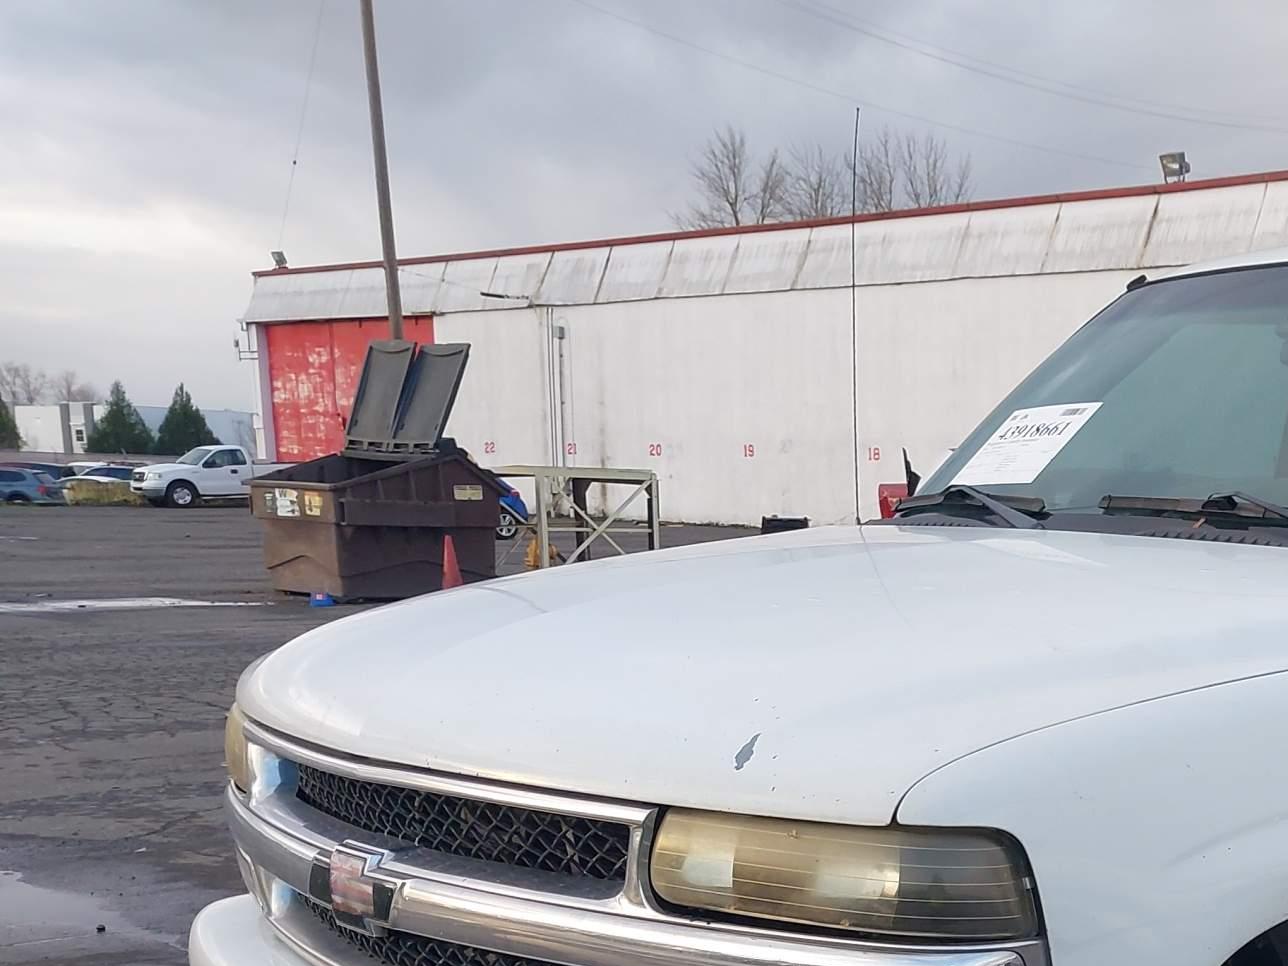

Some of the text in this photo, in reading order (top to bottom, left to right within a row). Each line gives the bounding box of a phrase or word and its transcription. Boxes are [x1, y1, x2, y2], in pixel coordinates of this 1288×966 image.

[999, 420, 1073, 441] 43918661
[484, 442, 496, 453] 22
[567, 443, 577, 455] 21
[649, 444, 662, 456] 20
[743, 444, 755, 457] 19
[868, 447, 881, 461] 18
